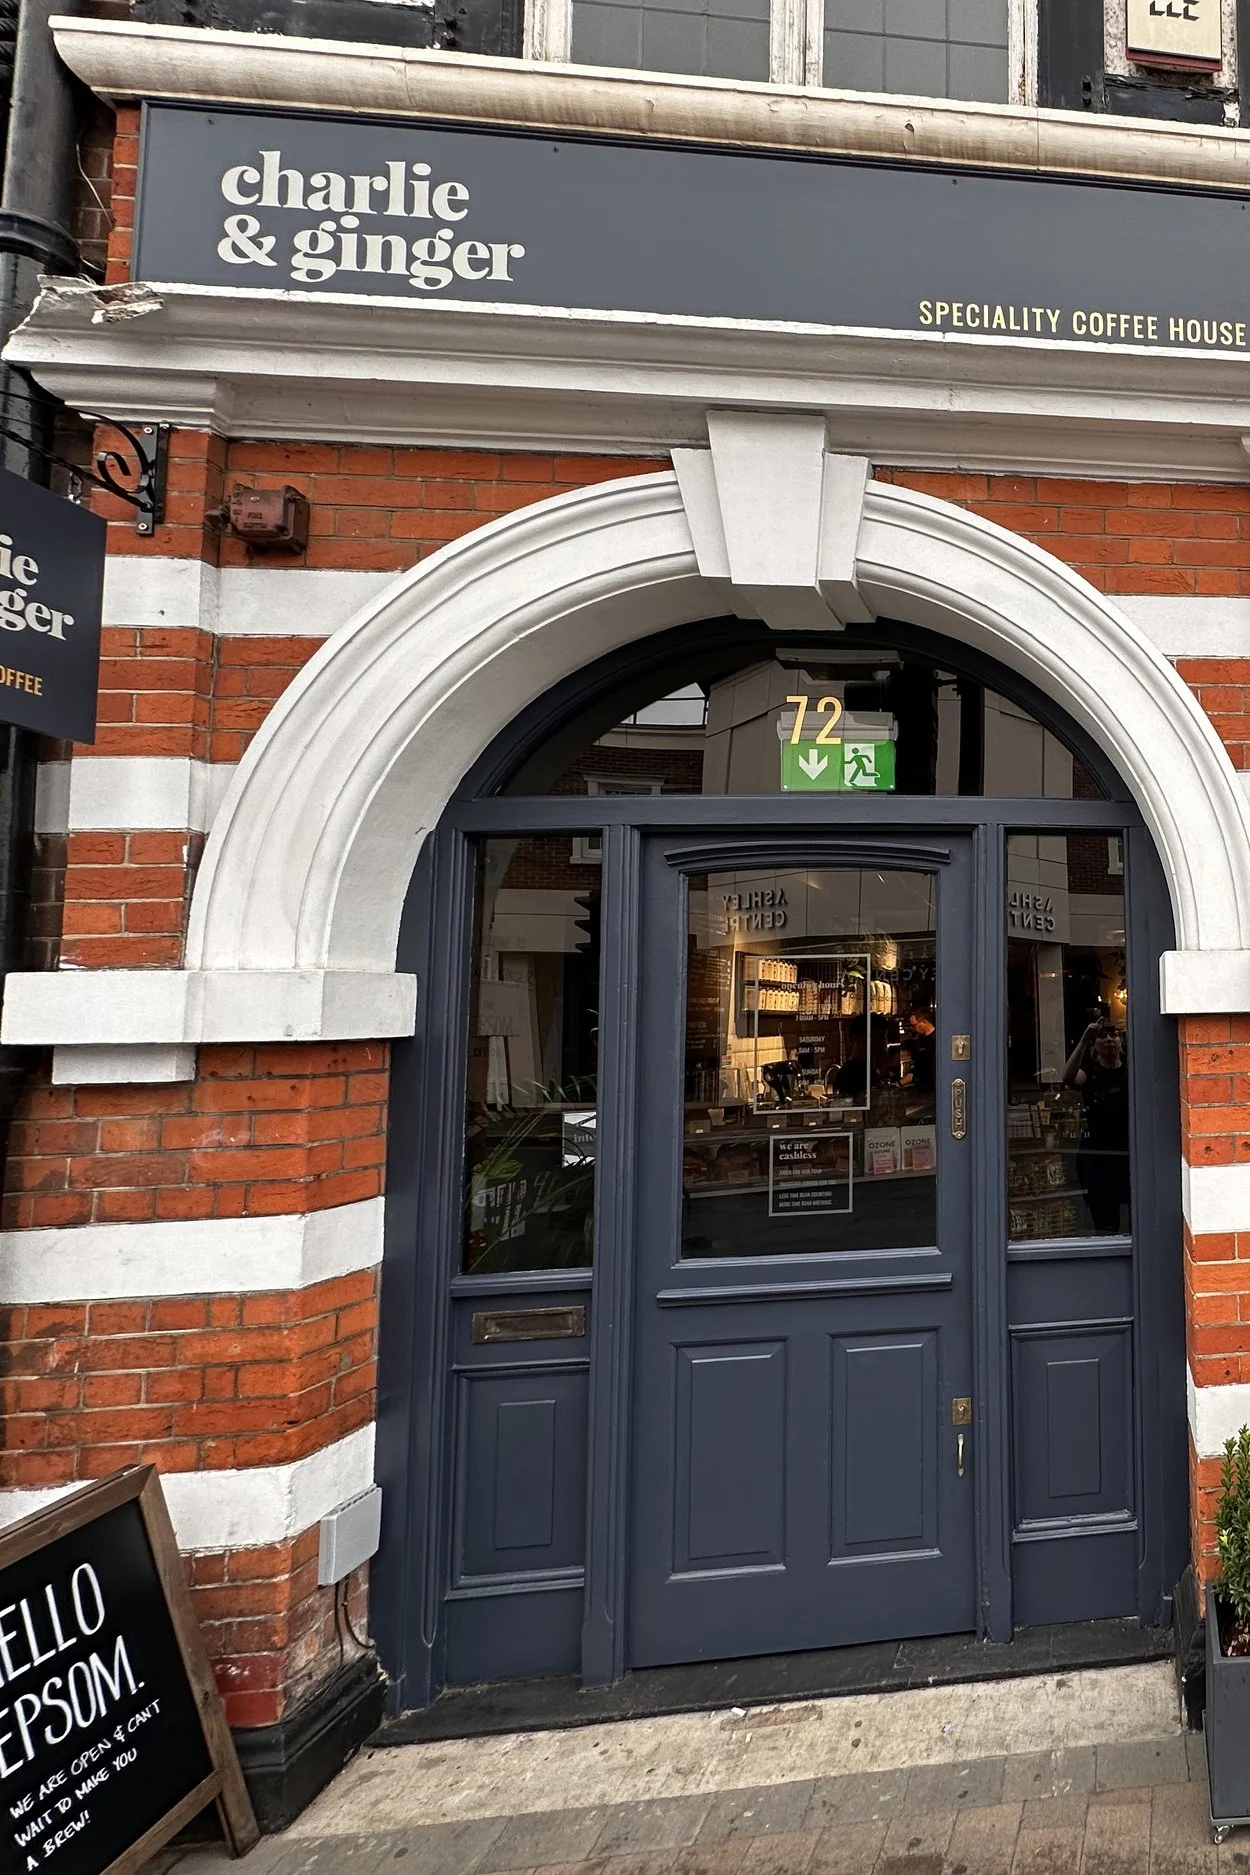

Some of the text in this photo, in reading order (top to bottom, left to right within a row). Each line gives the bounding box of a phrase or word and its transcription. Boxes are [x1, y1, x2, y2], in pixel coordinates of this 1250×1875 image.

[221, 150, 469, 221] charlie
[217, 214, 525, 290] & ginger
[919, 300, 1247, 347] SPECIALITY COFFEE HOUSE
[786, 695, 843, 745] 72
[799, 1035, 826, 1043] SATURDAY
[955, 1088, 963, 1128] PUSH
[779, 1151, 817, 1160] cashless
[793, 1142, 809, 1150] are
[868, 1141, 896, 1149] OZONE
[904, 1138, 932, 1146] OZONE
[0, 1563, 105, 1688] ELLO
[10, 1792, 35, 1819] WE
[39, 1768, 68, 1800] ARE
[70, 1738, 112, 1776] OPEN
[113, 1725, 126, 1743] &
[14, 1747, 138, 1847] WAIT TO MAKE YOU
[26, 1809, 92, 1872] A BREW!
